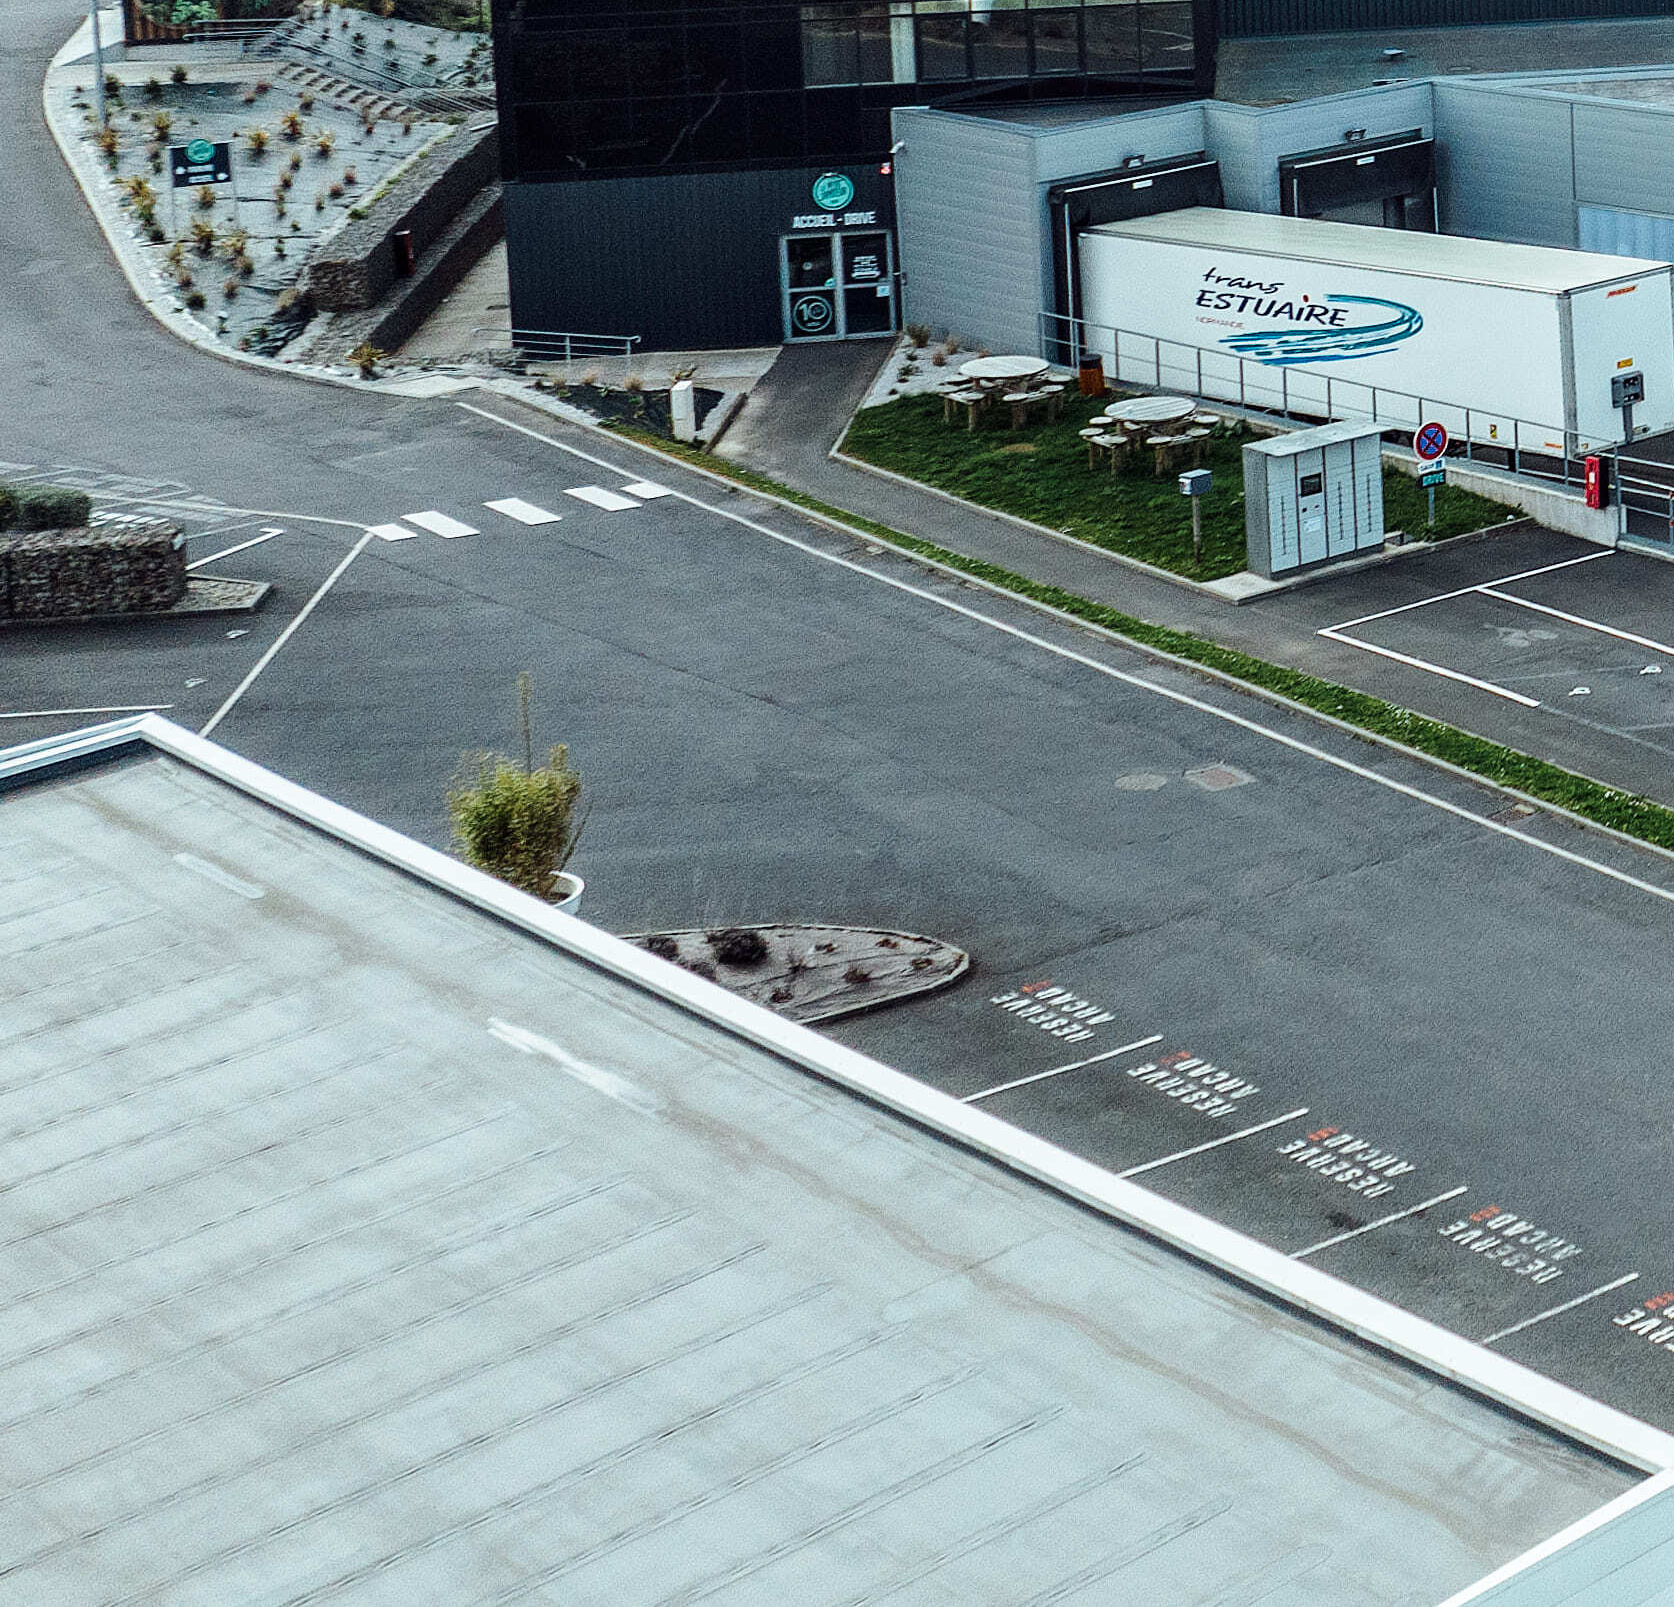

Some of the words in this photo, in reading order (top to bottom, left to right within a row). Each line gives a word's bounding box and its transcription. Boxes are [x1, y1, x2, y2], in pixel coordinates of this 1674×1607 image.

[792, 214, 837, 229] ACCUEIL
[844, 211, 876, 225] DRIVE
[1203, 267, 1284, 294] trans
[989, 991, 1095, 1043] RESERVE
[1127, 1063, 1237, 1118] RESERVE
[1277, 1139, 1394, 1198] RESERVE
[1438, 1220, 1563, 1284] RESERVE
